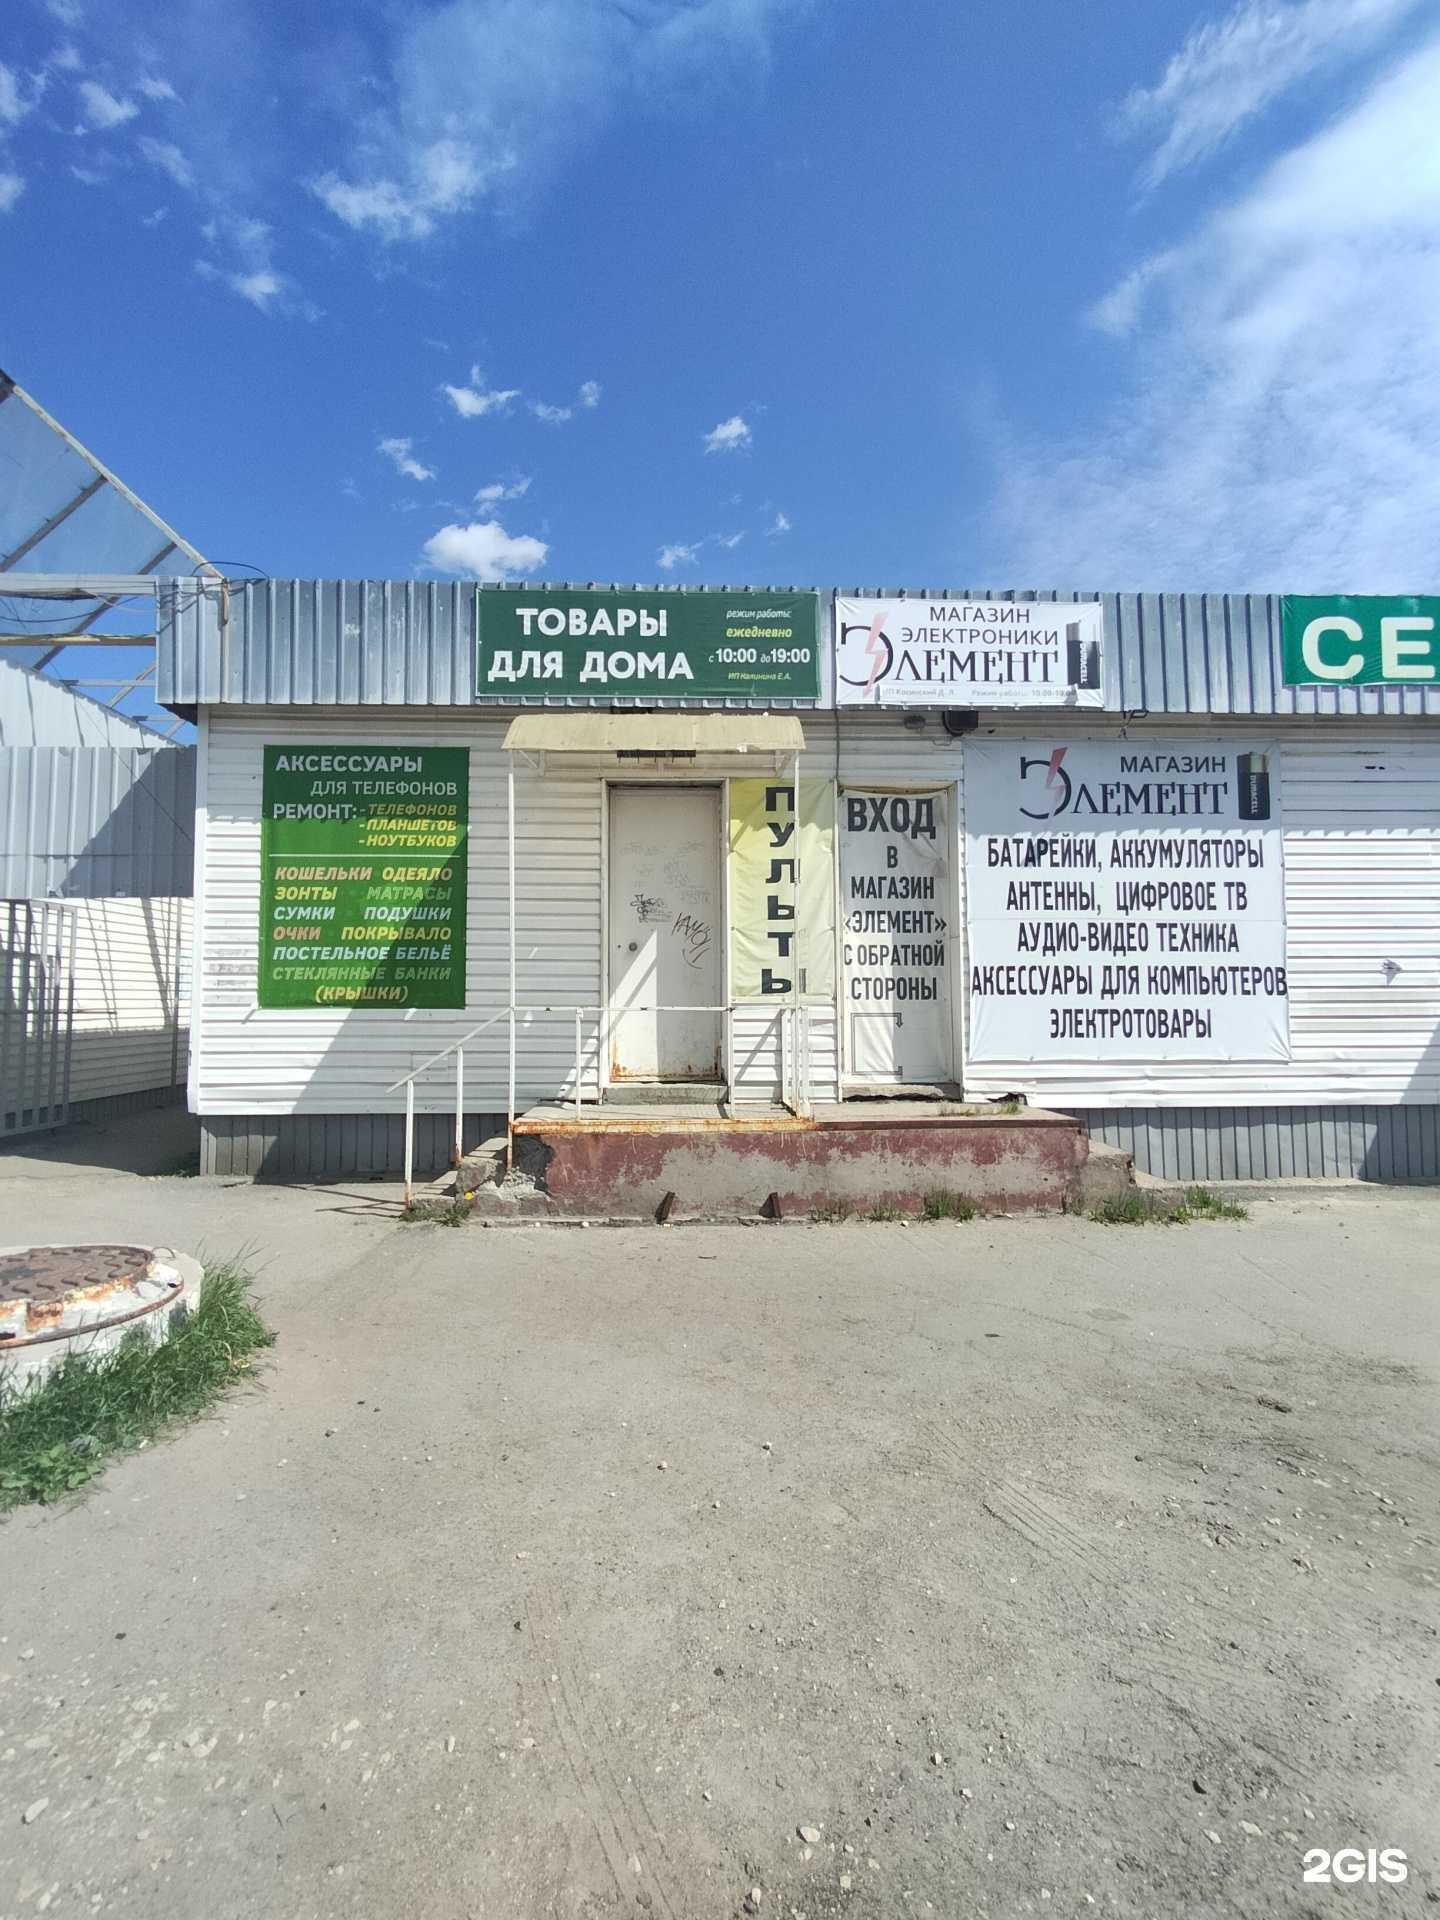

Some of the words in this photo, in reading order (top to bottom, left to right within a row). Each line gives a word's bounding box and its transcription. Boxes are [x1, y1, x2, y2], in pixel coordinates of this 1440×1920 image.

[516, 608, 667, 637] ТОВАРЫ
[726, 609, 756, 619] режим
[930, 606, 1030, 623] МАГАЗИН
[726, 626, 793, 638] ежедневно
[902, 627, 1059, 646] ЭЛЕКТРОНИКИ
[715, 648, 757, 663] 10:00
[760, 653, 771, 663] до
[770, 648, 811, 663] 19:00
[487, 650, 564, 682] ДЛЯ
[579, 652, 695, 683] ДОМА
[275, 755, 423, 773] АКСЕССУАРЫ
[1120, 756, 1226, 773] МАГАЗИН
[310, 781, 347, 797] ДЛЯ
[352, 782, 458, 796] ТЕЛЕФОНОВ
[273, 804, 358, 819] РЕМОНТ:
[847, 797, 937, 840] ВХОД
[887, 845, 898, 869] В
[987, 833, 1103, 872] БАТАРЕЙКИ,
[1110, 838, 1264, 868] АККУМУЛЯТОРЫ
[275, 866, 373, 881] КОШЕЛЬКИ
[382, 867, 453, 883] ОДЕЯЛО
[274, 886, 337, 901] ЗОНТЫ
[366, 887, 452, 901] МАТРАСЫ
[761, 786, 807, 994] ПУЛЬТЫ
[851, 876, 935, 900] МАГАЗИН
[1006, 881, 1101, 915] АНТЕННЫ,
[1116, 881, 1217, 915] ЦИФРОВОЕ
[1223, 882, 1248, 911] ТВ
[273, 906, 335, 920] СУМКИ
[364, 907, 452, 923] ПОДУШКИ
[272, 926, 321, 941] ОЧКИ
[341, 926, 451, 941] ПОКРЫВАЛО
[1017, 922, 1149, 957] АУДИО-ВИДЕО
[1156, 922, 1240, 953] ТЕХНИКА
[272, 946, 390, 961] ПОСТЕЛЬНОЕ
[395, 944, 452, 961] БЕЛЬЁ
[844, 944, 853, 966] С
[858, 940, 945, 967] ОБРАТНОЙ
[272, 966, 385, 981] СТЕКЛЯННЫЕ
[394, 968, 451, 982] БАНКИ
[971, 965, 1093, 996] АКСЕССУАРЫ
[1100, 965, 1140, 1000] ДЛЯ
[1149, 966, 1288, 997] КОМПЬЮТЕРОВ
[315, 985, 409, 1003] (КРЫШКИ)
[851, 977, 937, 1001] СТОРОНЫ
[1050, 1008, 1213, 1039] ЭЛЕКТРОТОВАРЫ
